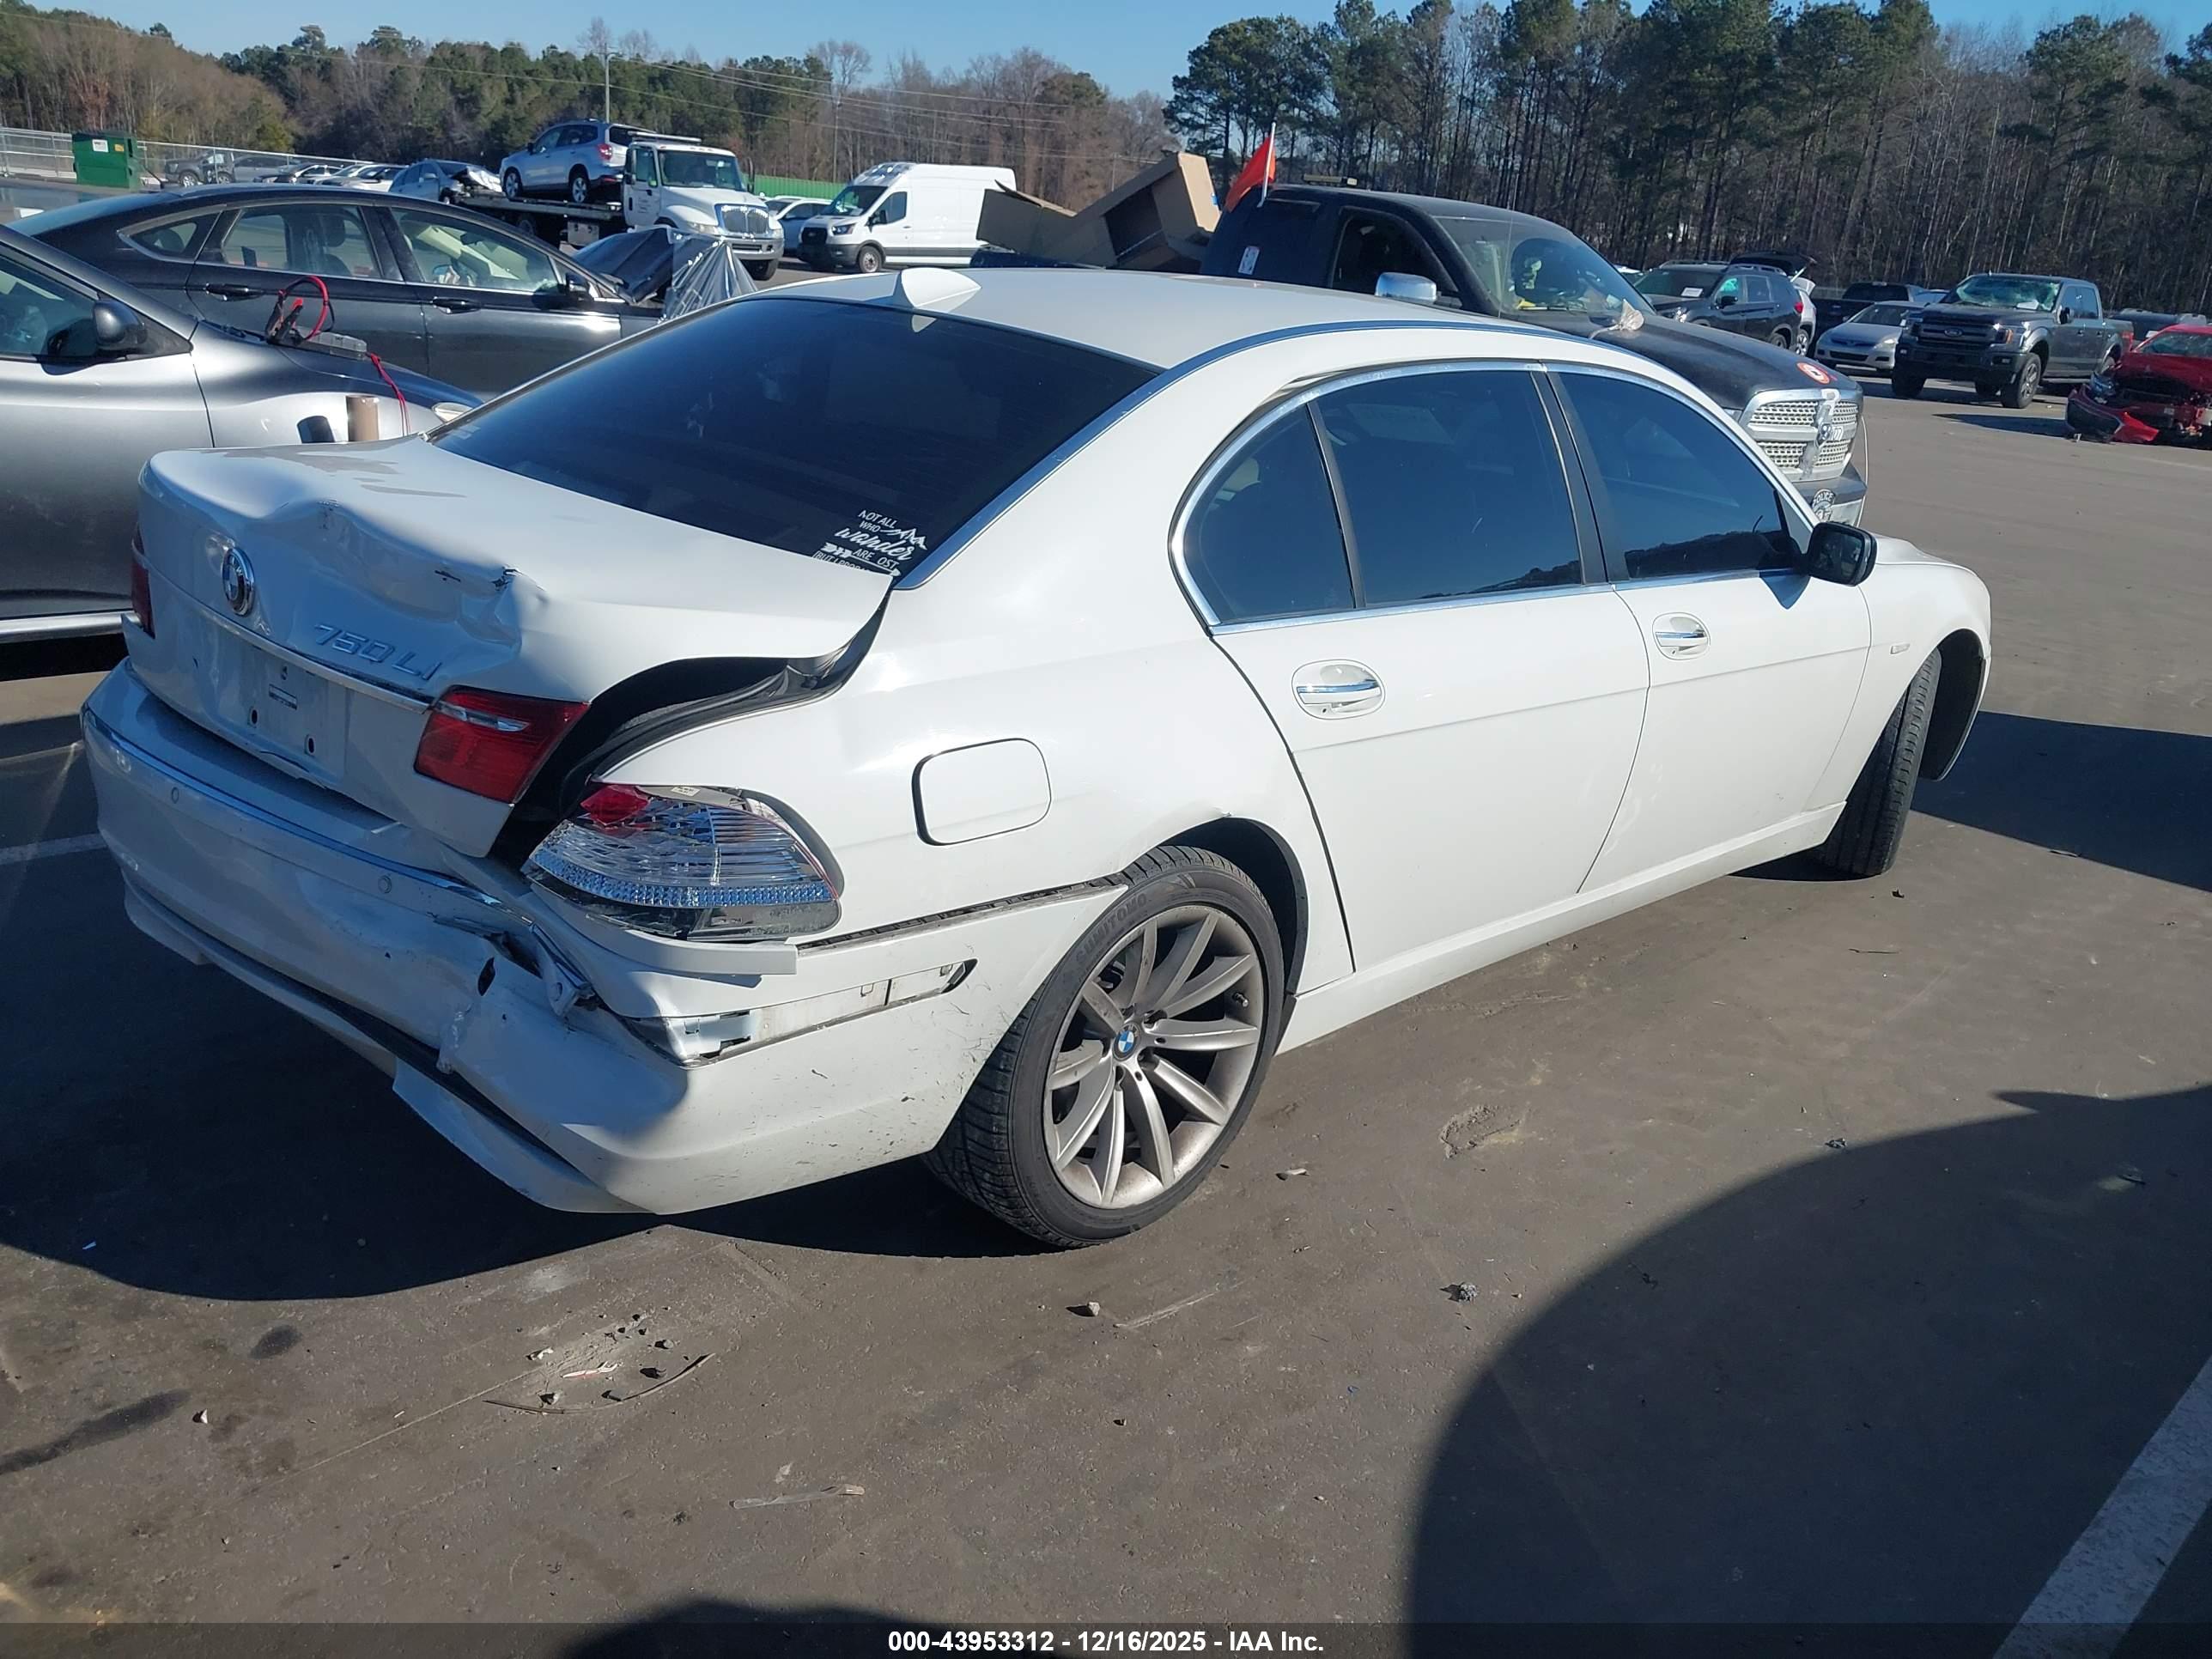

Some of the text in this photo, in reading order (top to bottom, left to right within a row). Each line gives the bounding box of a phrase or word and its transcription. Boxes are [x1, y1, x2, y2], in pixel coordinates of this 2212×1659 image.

[859, 509, 897, 529] NOT ALL
[860, 520, 880, 532] WHO
[834, 527, 915, 561] wander
[852, 548, 875, 561] ARE
